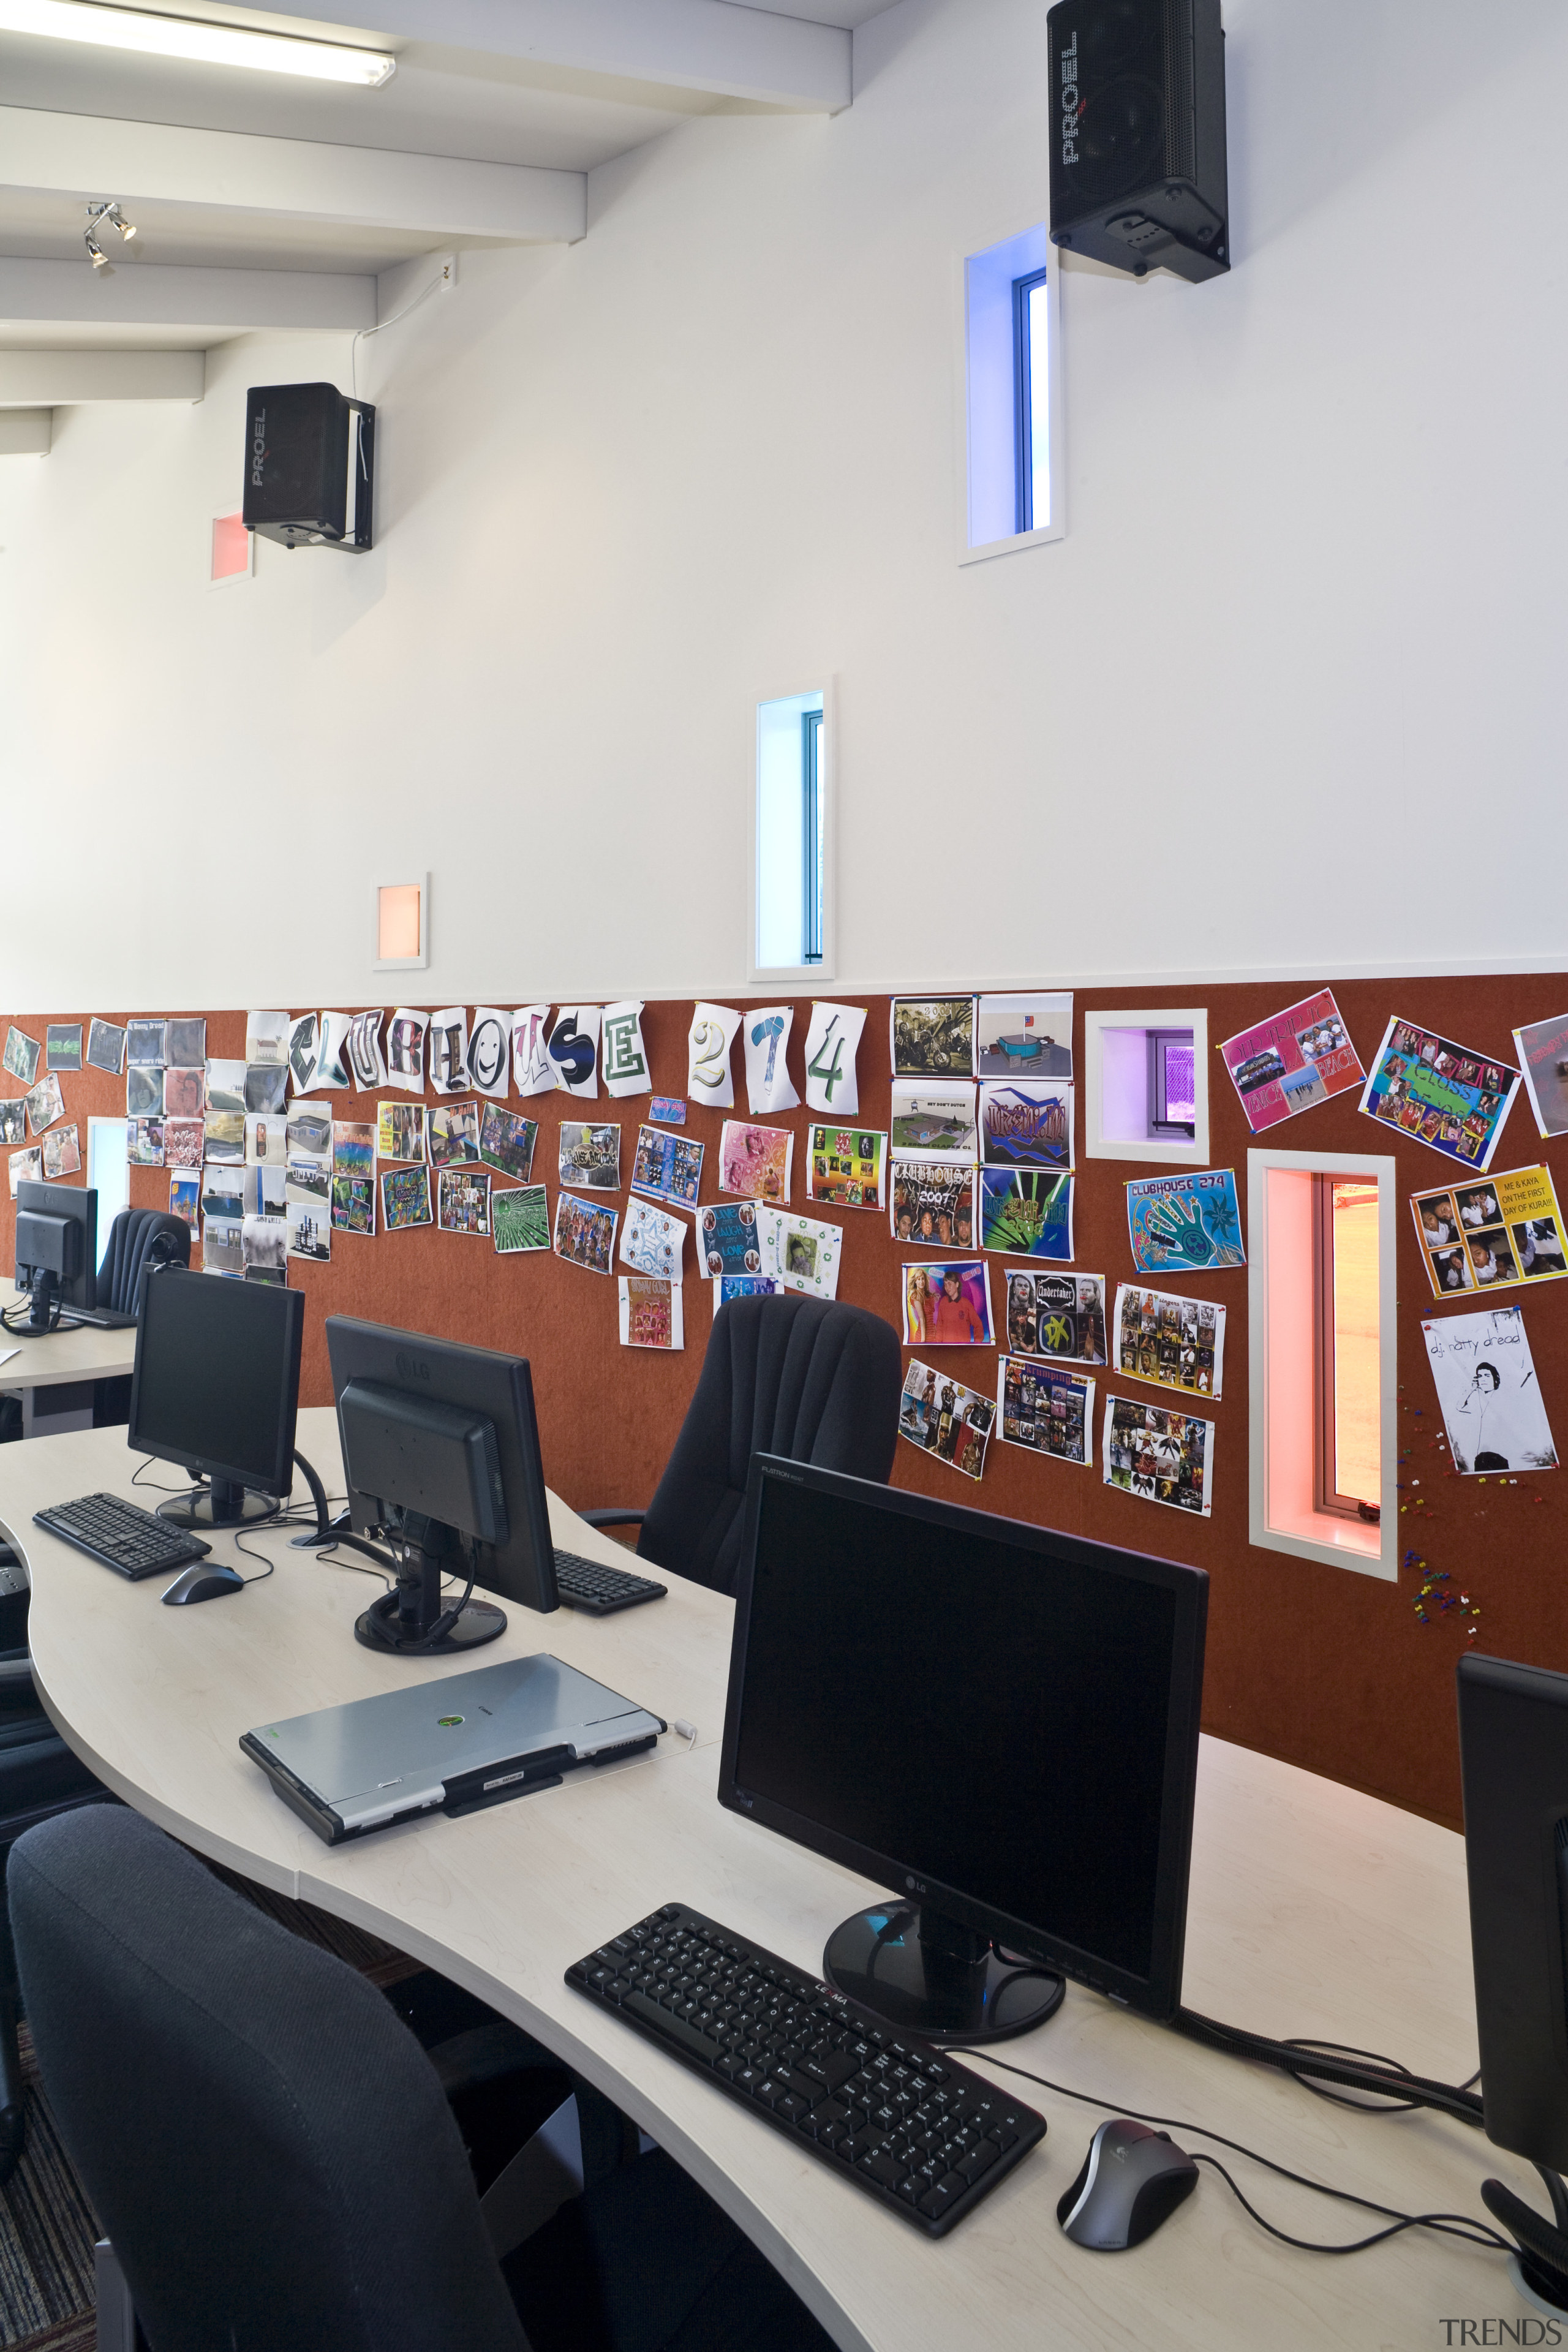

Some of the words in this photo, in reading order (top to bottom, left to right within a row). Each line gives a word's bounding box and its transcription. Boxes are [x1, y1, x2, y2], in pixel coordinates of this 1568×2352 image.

[1063, 32, 1079, 165] PROEL
[252, 407, 266, 486] PROEL
[1229, 1036, 1262, 1065] OUR
[1266, 1015, 1303, 1046] TRIP
[1308, 1000, 1332, 1025] TO
[692, 1014, 845, 1102] 274
[1316, 1047, 1356, 1080] BEACH
[1243, 1081, 1282, 1115] VENICE
[1132, 1179, 1194, 1196] CLUBHOUSE
[1199, 1175, 1224, 1188] 274
[1504, 1182, 1514, 1191] ME
[1521, 1177, 1539, 1187] KAYA
[919, 1191, 951, 1204] 2007
[1502, 1195, 1513, 1204] ON
[1513, 1192, 1526, 1200] THE
[1528, 1188, 1545, 1198] FIRST
[1503, 1206, 1517, 1216] DAY
[1528, 1198, 1553, 1210] KURA!!!
[717, 1225, 744, 1237] LAUGH
[1038, 1286, 1072, 1299] Undertaker
[1159, 1298, 1180, 1307] singers
[1044, 1316, 1069, 1349] DX
[1449, 1336, 1479, 1356] natty
[1483, 1324, 1520, 1346] dread
[412, 1360, 429, 1380] LG
[1027, 1364, 1071, 1385] krumping
[916, 1882, 926, 1893] LG
[815, 1984, 847, 2005] LEXMA
